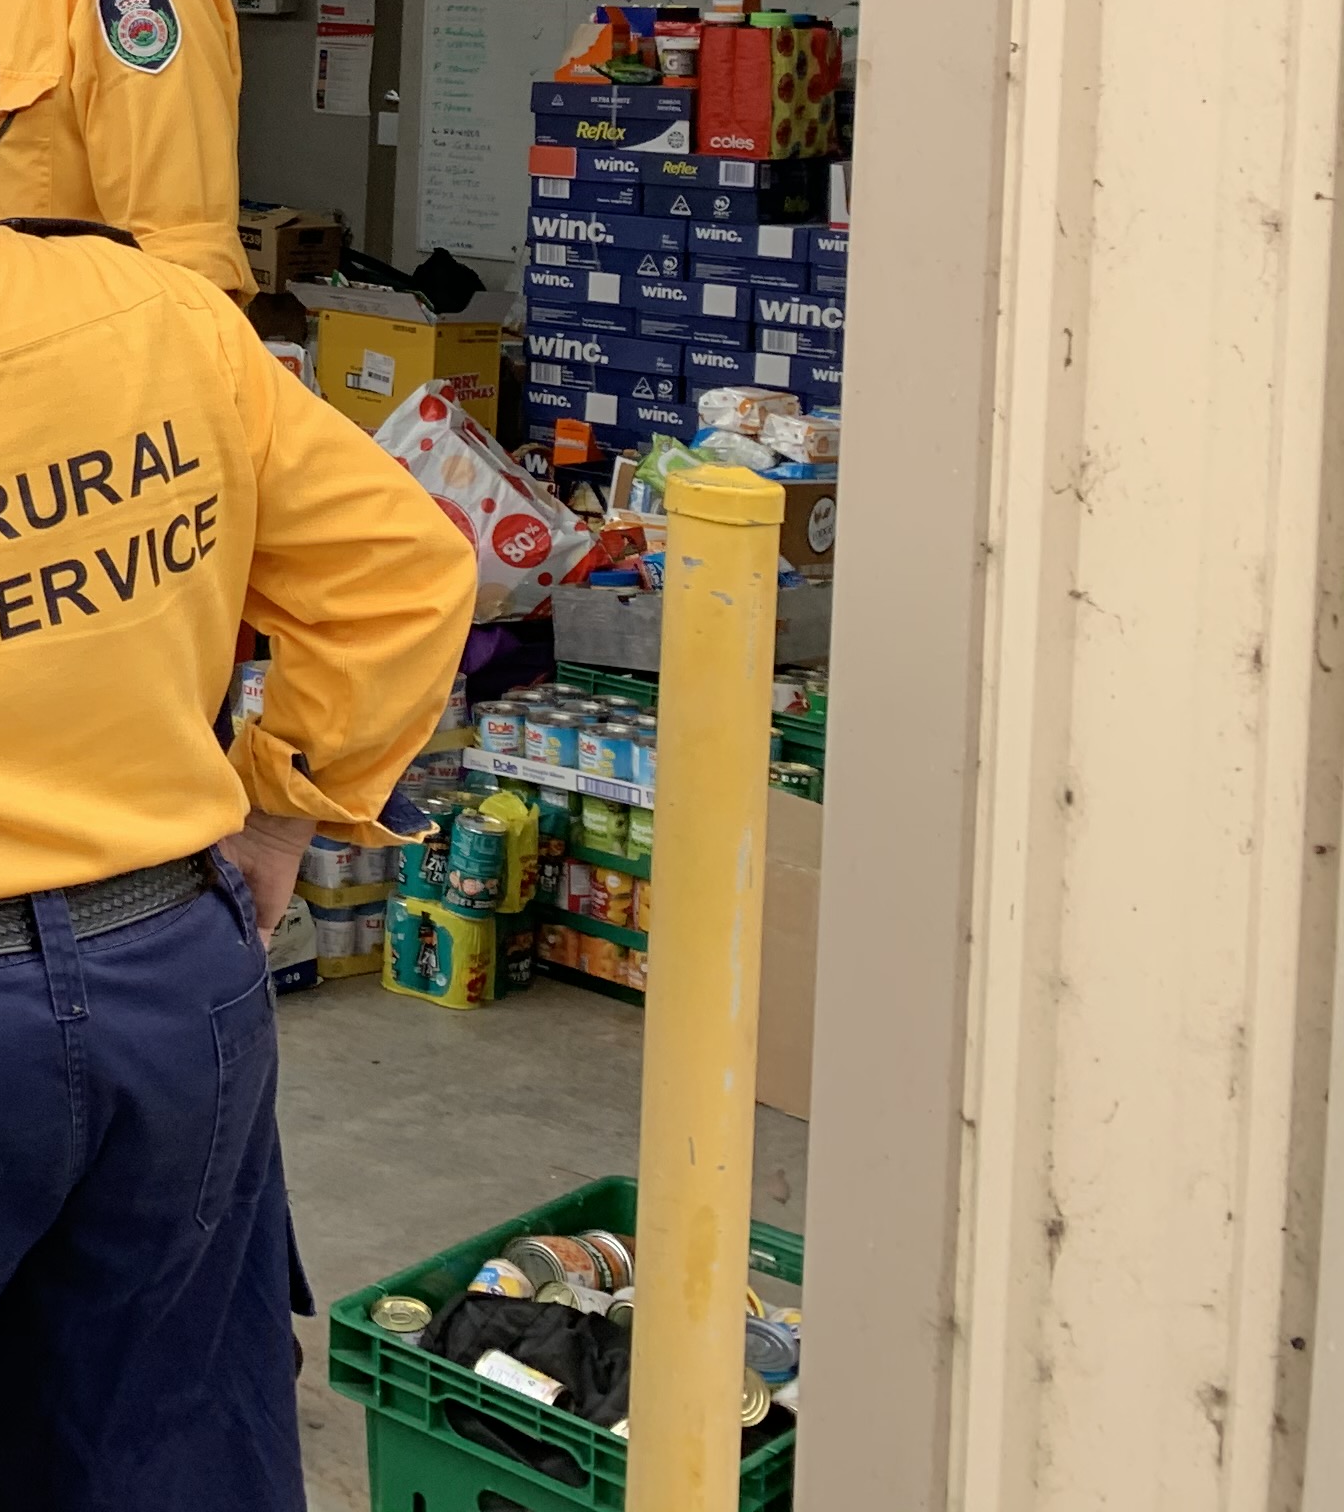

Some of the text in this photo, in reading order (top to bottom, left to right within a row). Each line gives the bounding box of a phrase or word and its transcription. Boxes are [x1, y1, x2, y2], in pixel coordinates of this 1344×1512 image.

[576, 120, 627, 142] Reflex
[710, 135, 755, 152] coles
[594, 156, 639, 173] winc.
[662, 161, 698, 176] Reflex
[531, 214, 615, 244] winc.
[695, 225, 743, 244] winc.
[530, 271, 574, 289] winc.
[642, 284, 688, 302] winc.
[529, 333, 609, 365] winc.
[691, 351, 739, 370] winc.
[528, 390, 571, 408] winc.
[638, 406, 683, 425] winc.
[525, 453, 548, 475] W
[502, 521, 540, 563] 80%
[488, 721, 514, 734] Dole
[493, 758, 518, 774] Dole
